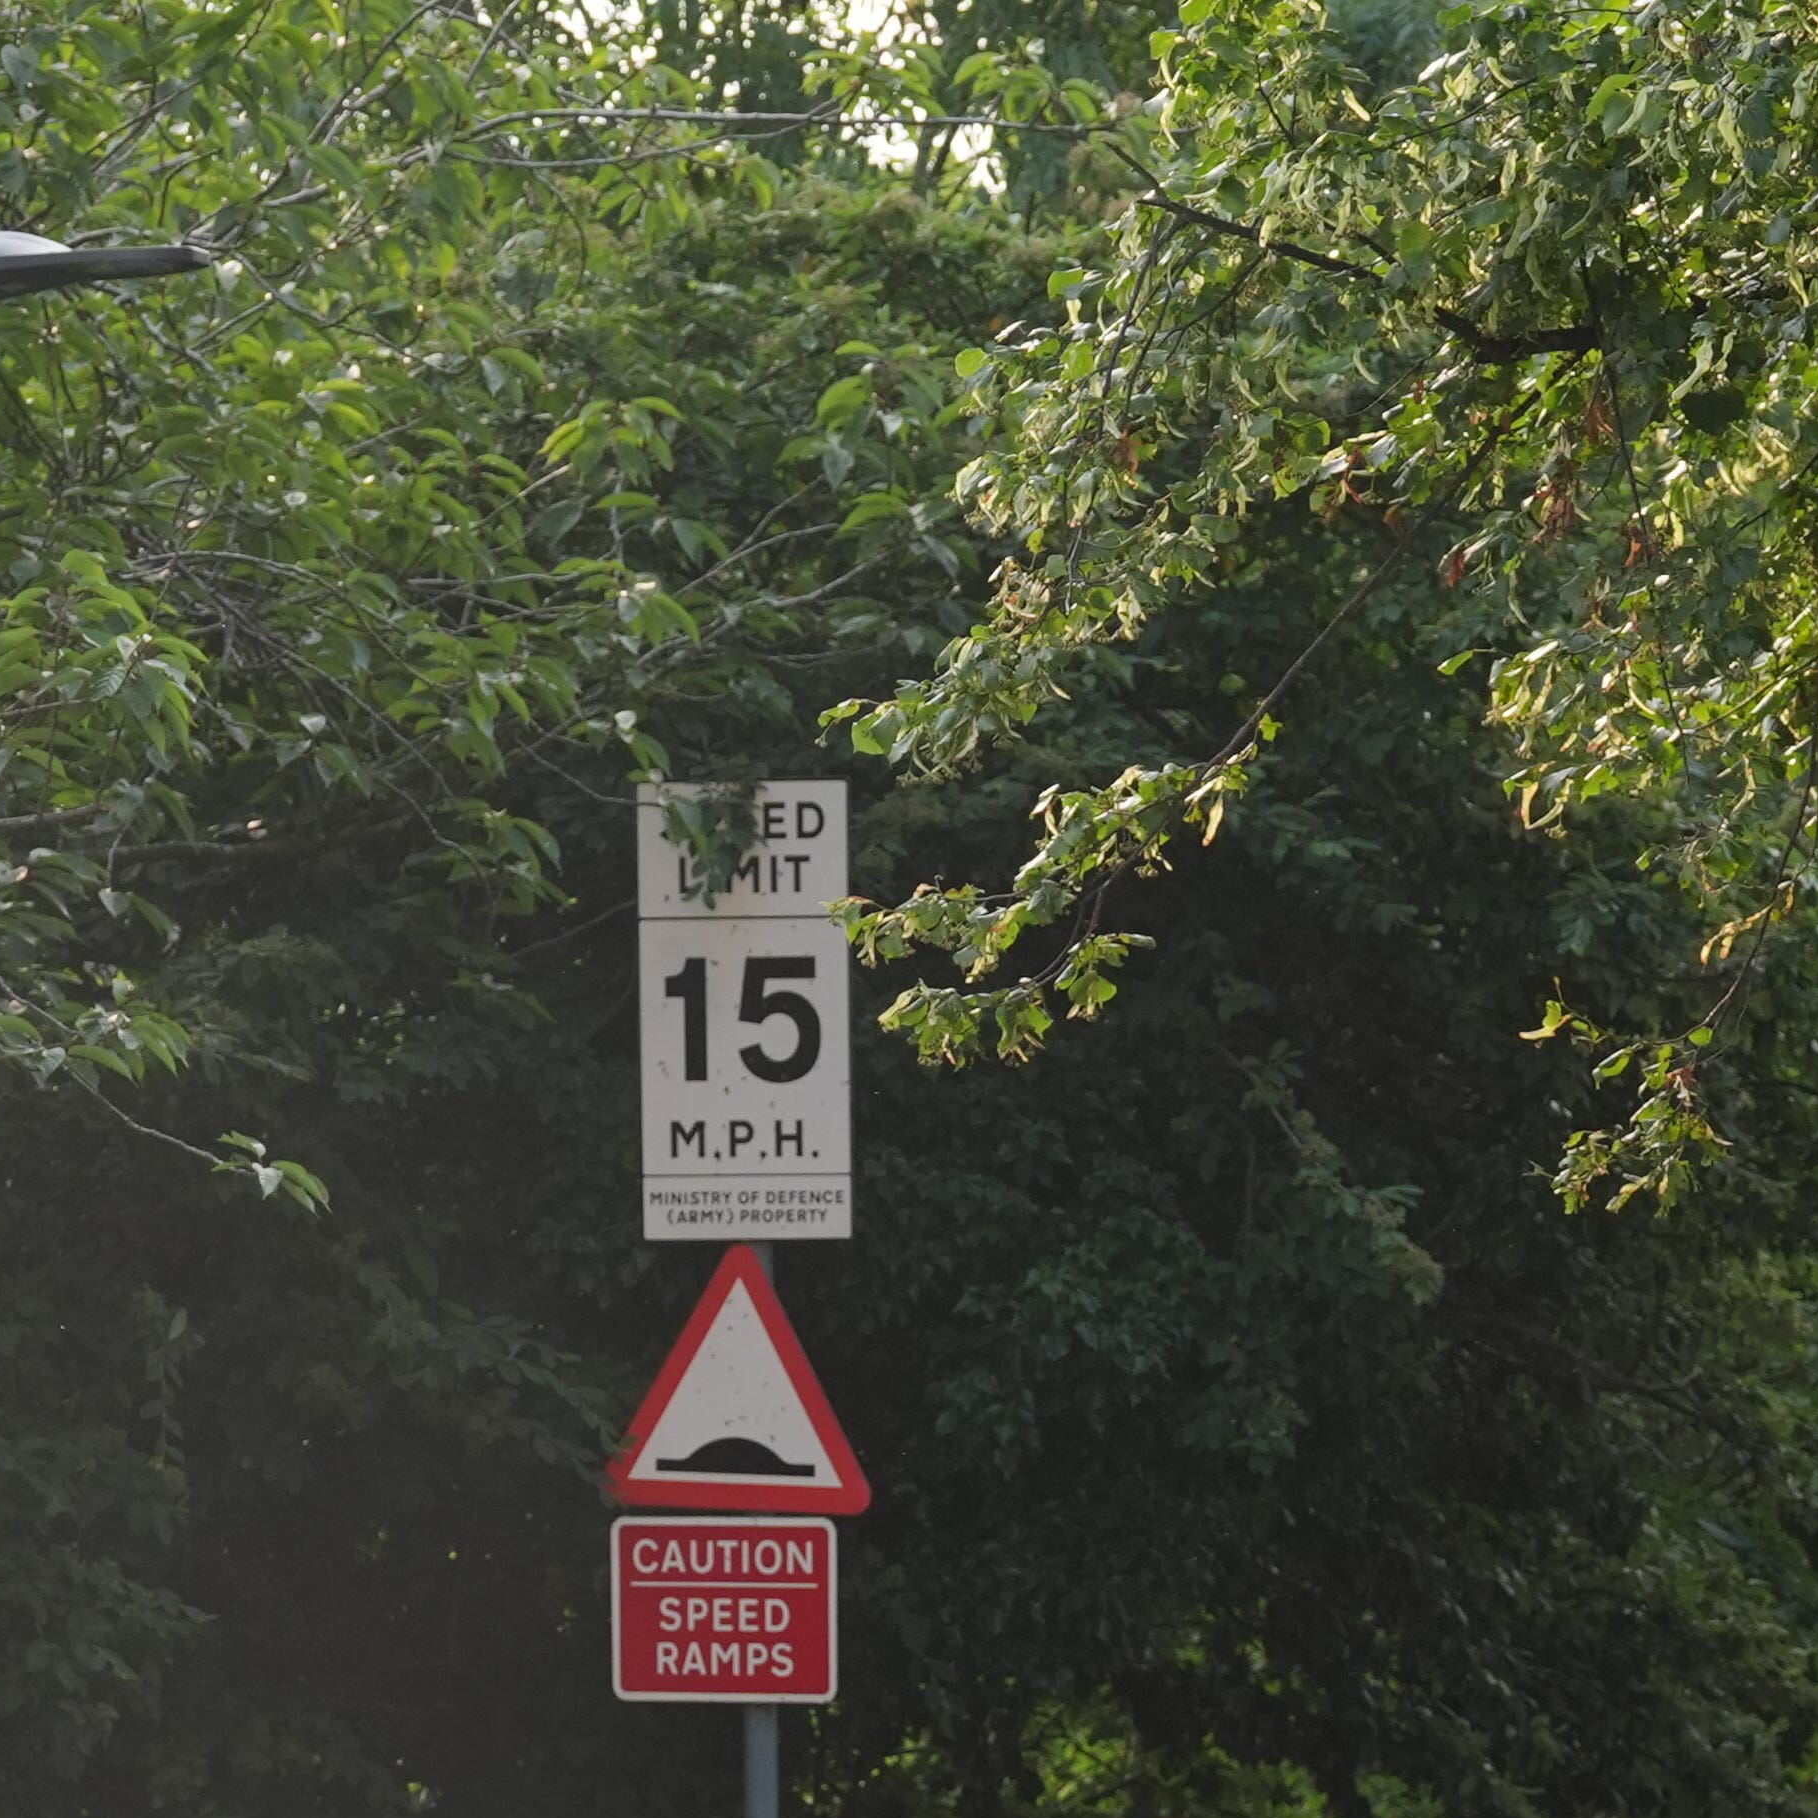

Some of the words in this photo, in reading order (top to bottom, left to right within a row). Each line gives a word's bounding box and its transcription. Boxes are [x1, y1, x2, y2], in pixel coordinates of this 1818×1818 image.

[678, 855, 810, 893] LMIT
[665, 956, 821, 1083] 15
[649, 1190, 731, 1205] MINISTRY
[737, 1190, 760, 1204] OF
[765, 1189, 845, 1204] DEFENCE
[667, 1209, 734, 1225] (ARMY)
[739, 1208, 828, 1223] PROPERTY
[632, 1538, 813, 1575] CAUTION
[659, 1597, 791, 1633] SPEED
[656, 1641, 794, 1678] RAMPS
